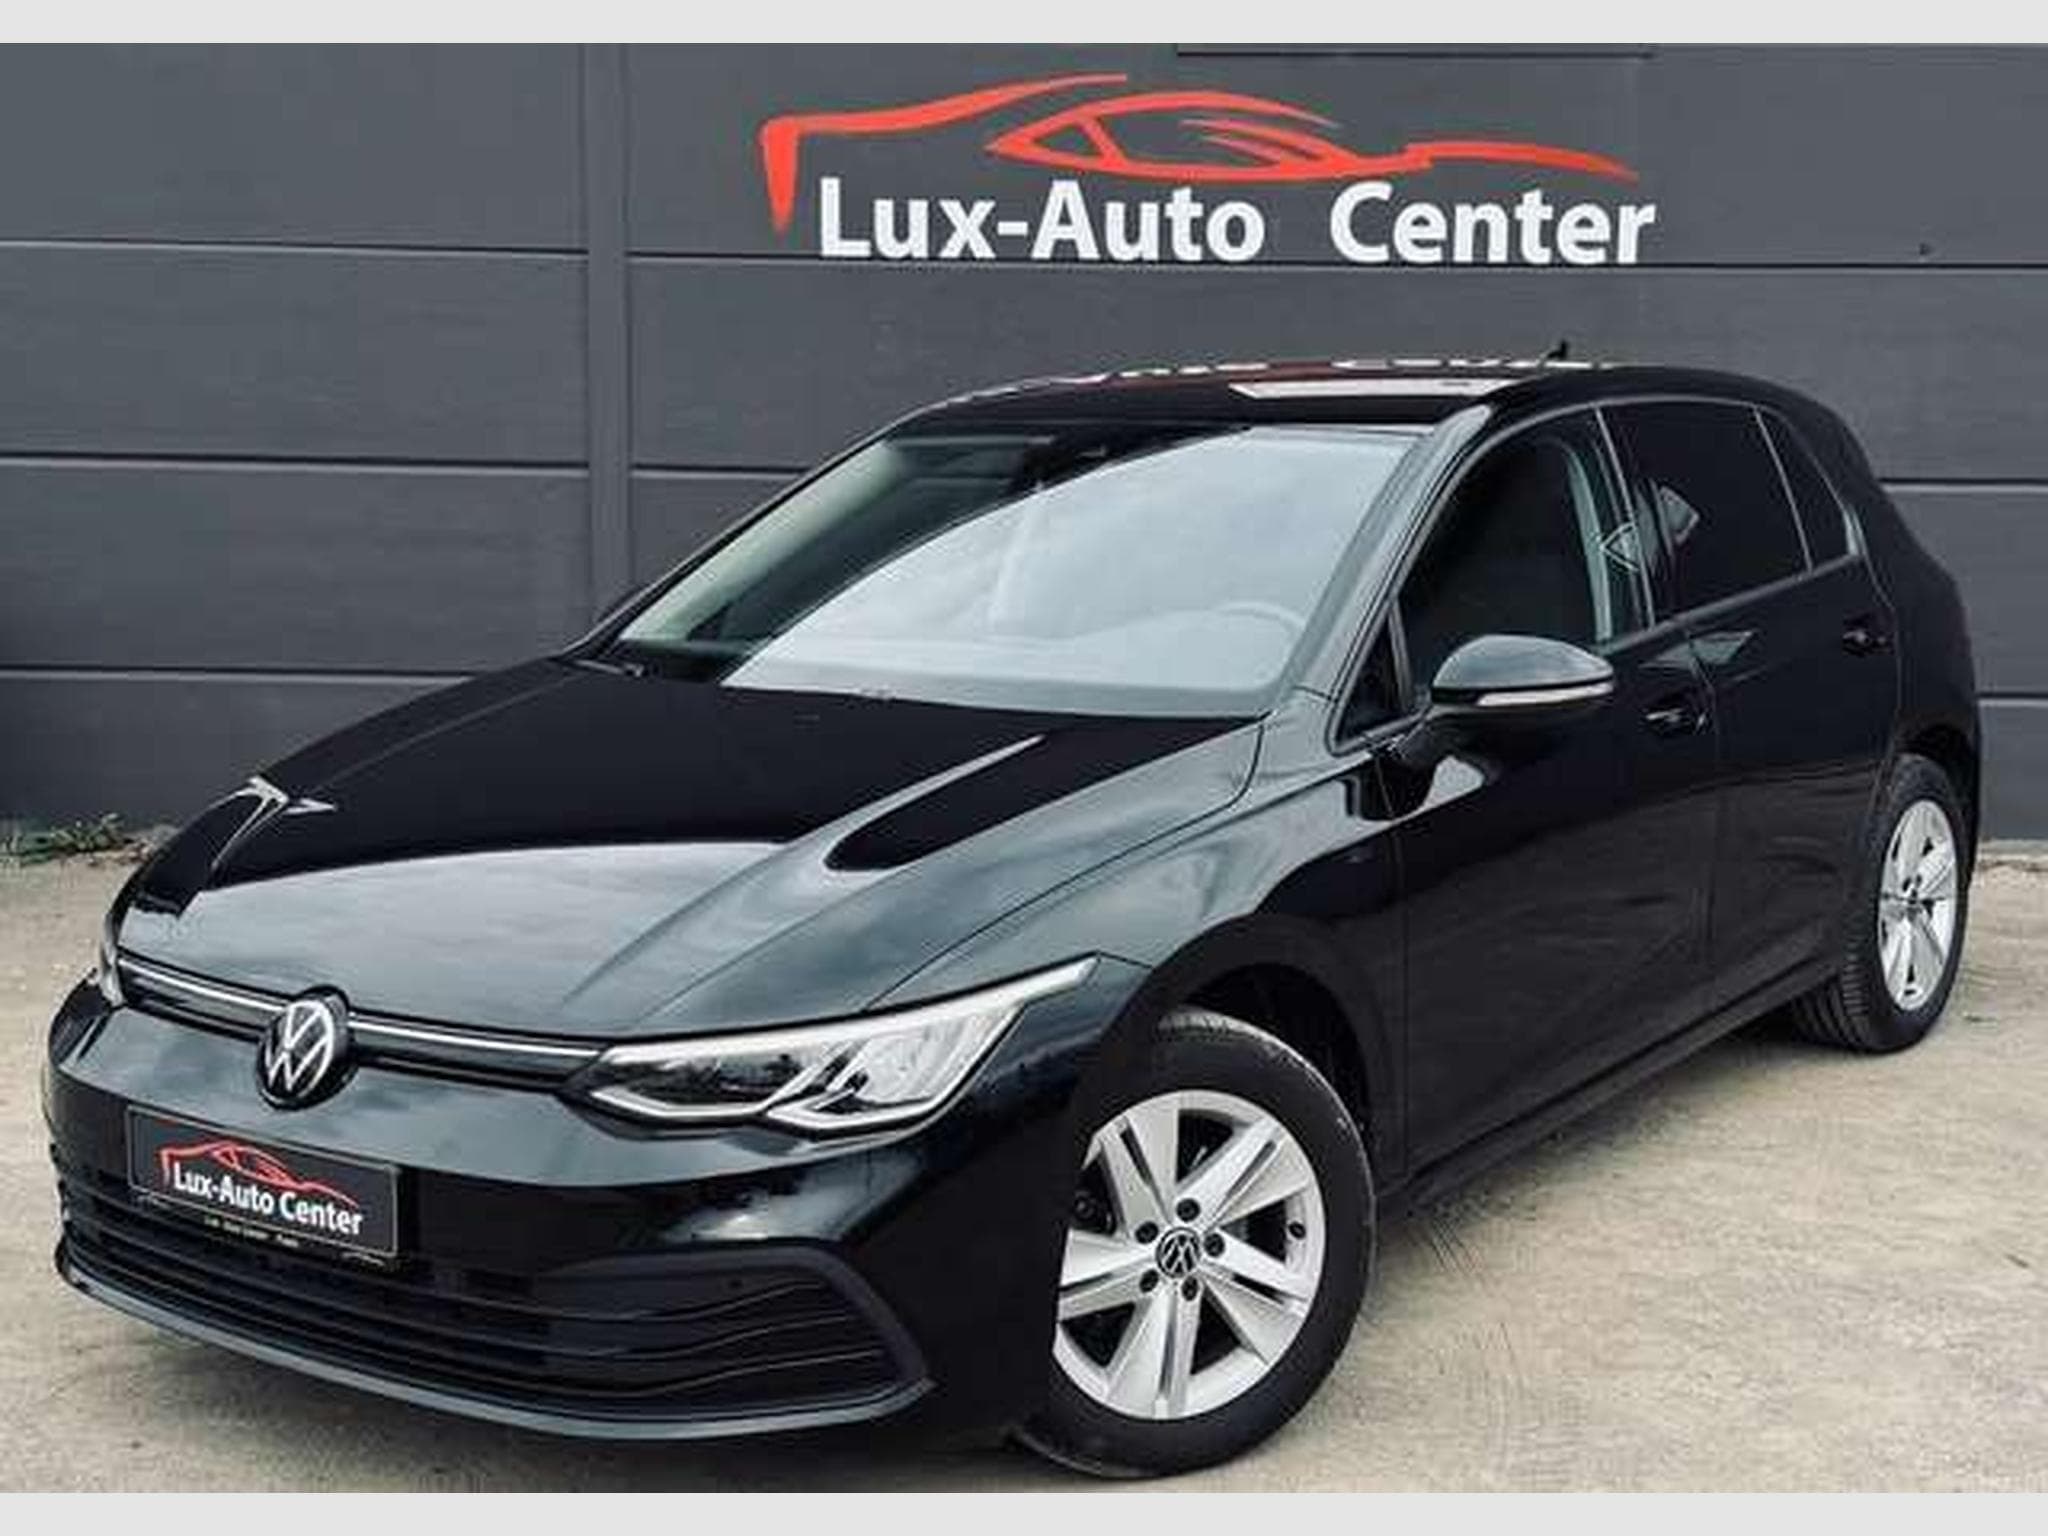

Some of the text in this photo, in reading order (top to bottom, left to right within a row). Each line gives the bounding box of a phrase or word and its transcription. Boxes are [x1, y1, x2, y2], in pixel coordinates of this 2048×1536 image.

[819, 177, 1656, 265] Lux-Auto Center
[173, 1161, 275, 1216] Lux-Auto
[278, 1191, 364, 1235] Center
